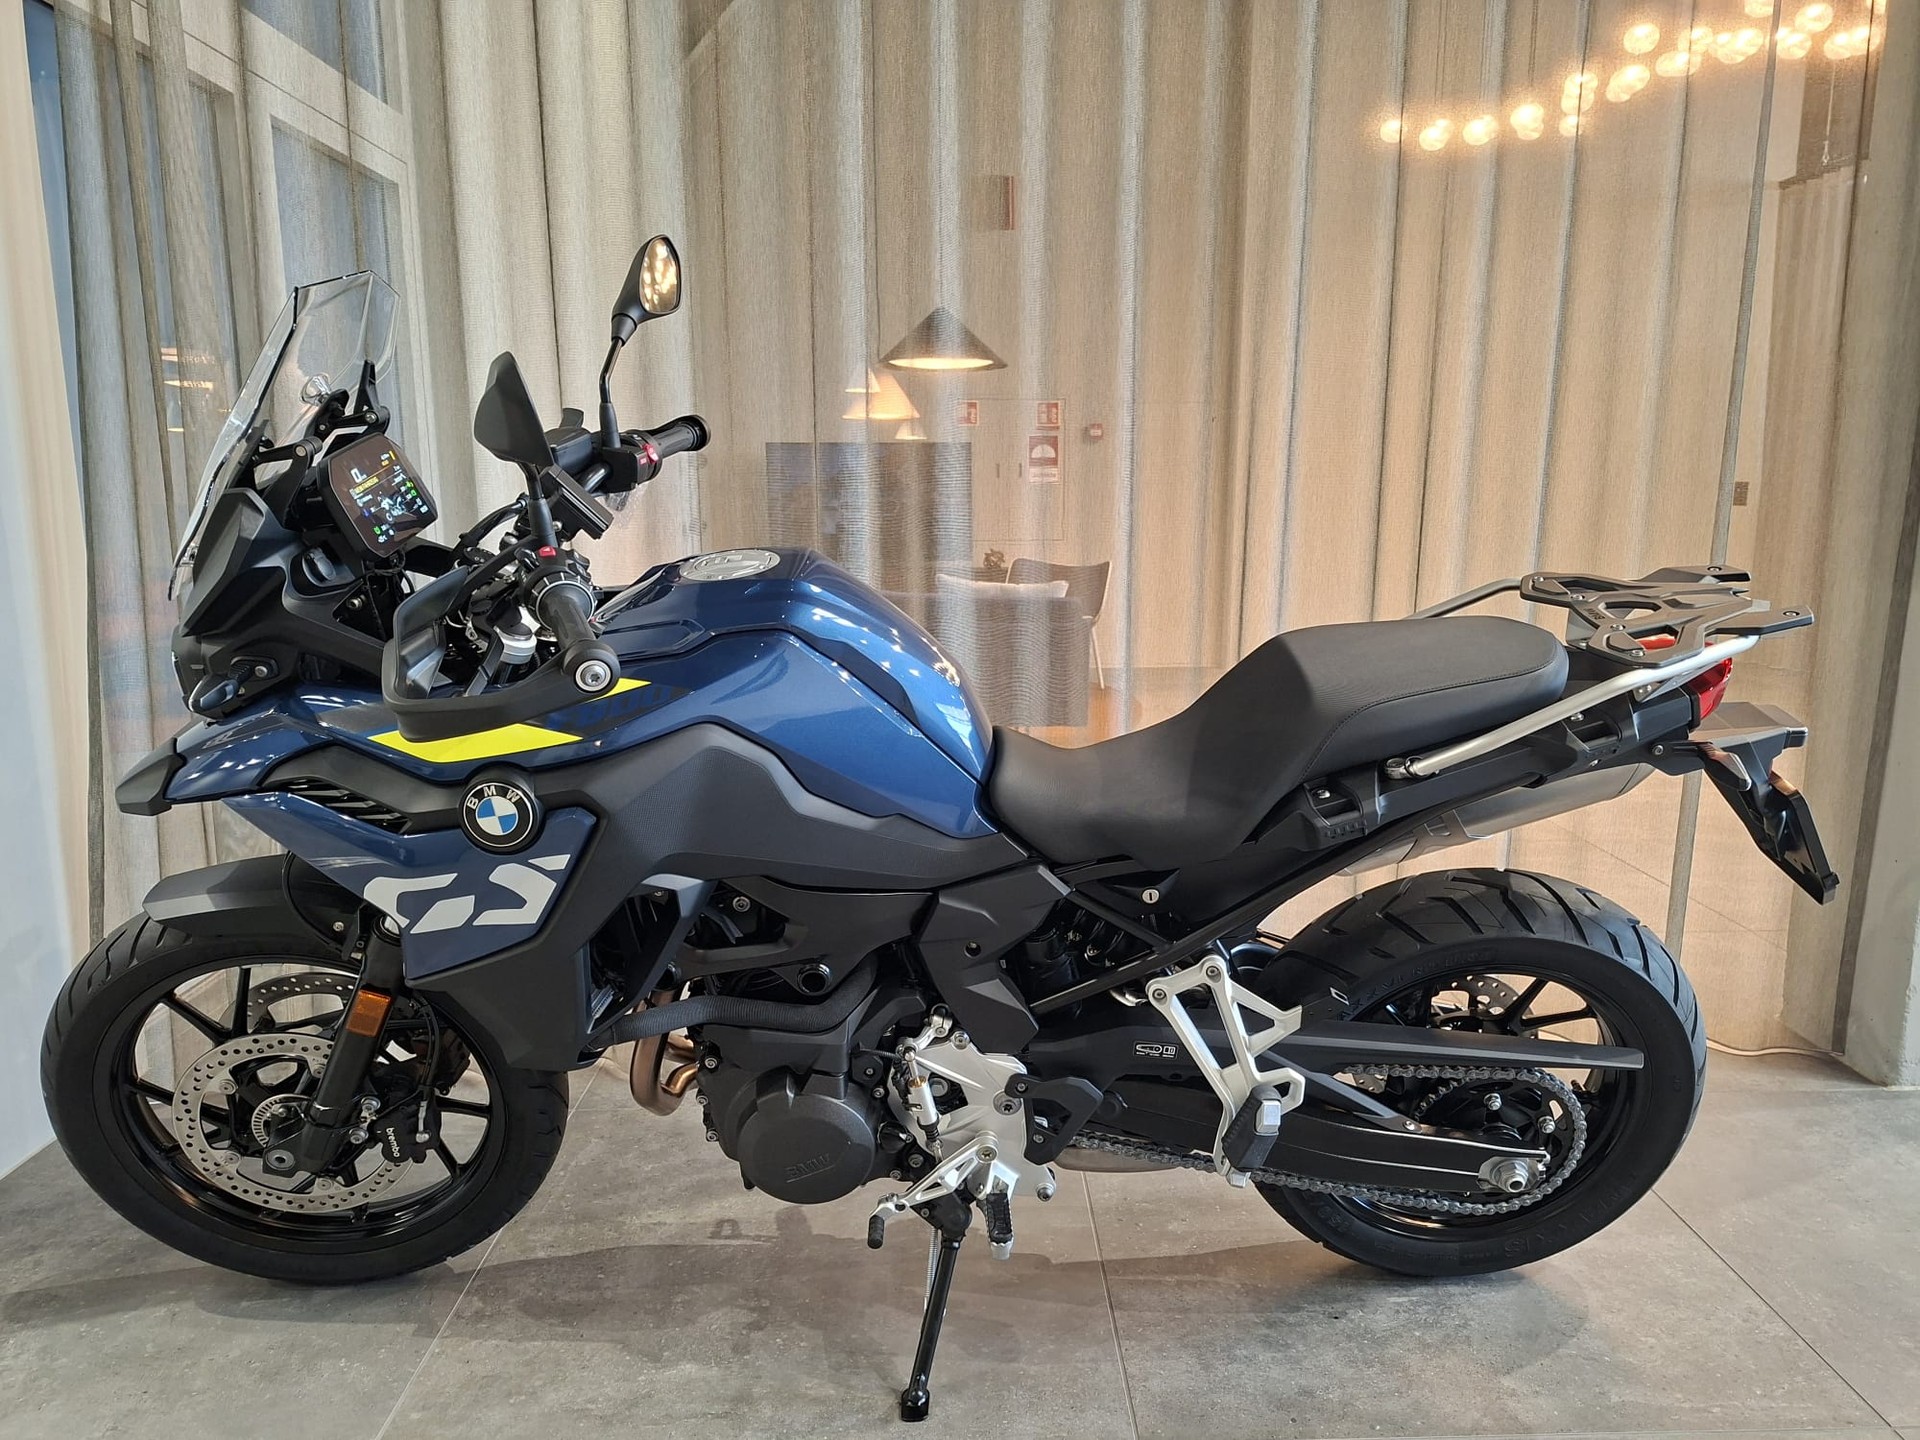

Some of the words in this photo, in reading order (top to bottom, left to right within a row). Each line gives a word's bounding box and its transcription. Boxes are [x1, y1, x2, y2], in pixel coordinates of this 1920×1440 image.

[467, 785, 522, 810] BMW
[363, 854, 571, 934] GS
[386, 1126, 400, 1158] brembo
